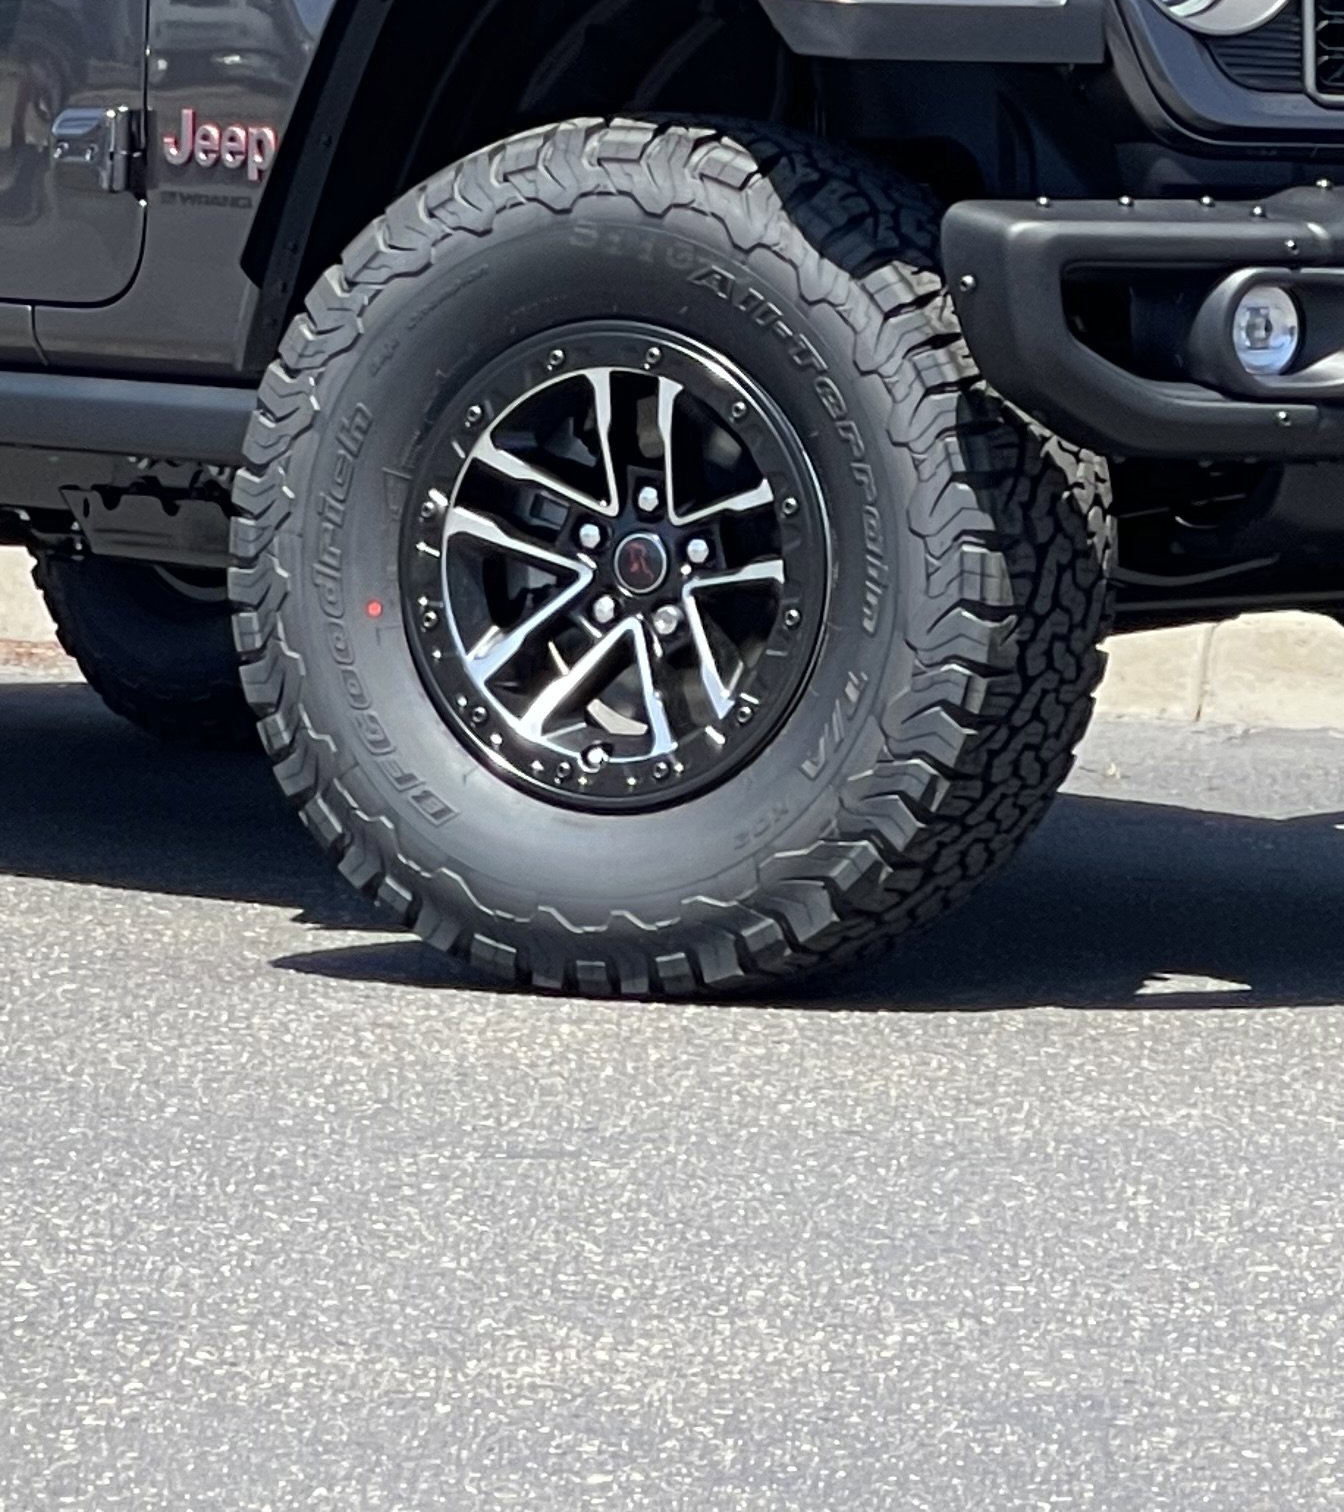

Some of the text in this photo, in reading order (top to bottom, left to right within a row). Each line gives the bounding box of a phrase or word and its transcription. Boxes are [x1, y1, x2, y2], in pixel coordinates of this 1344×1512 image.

[162, 108, 277, 181] Jeep
[312, 402, 460, 829] BFGoodrich
[692, 266, 880, 636] All-Terrain
